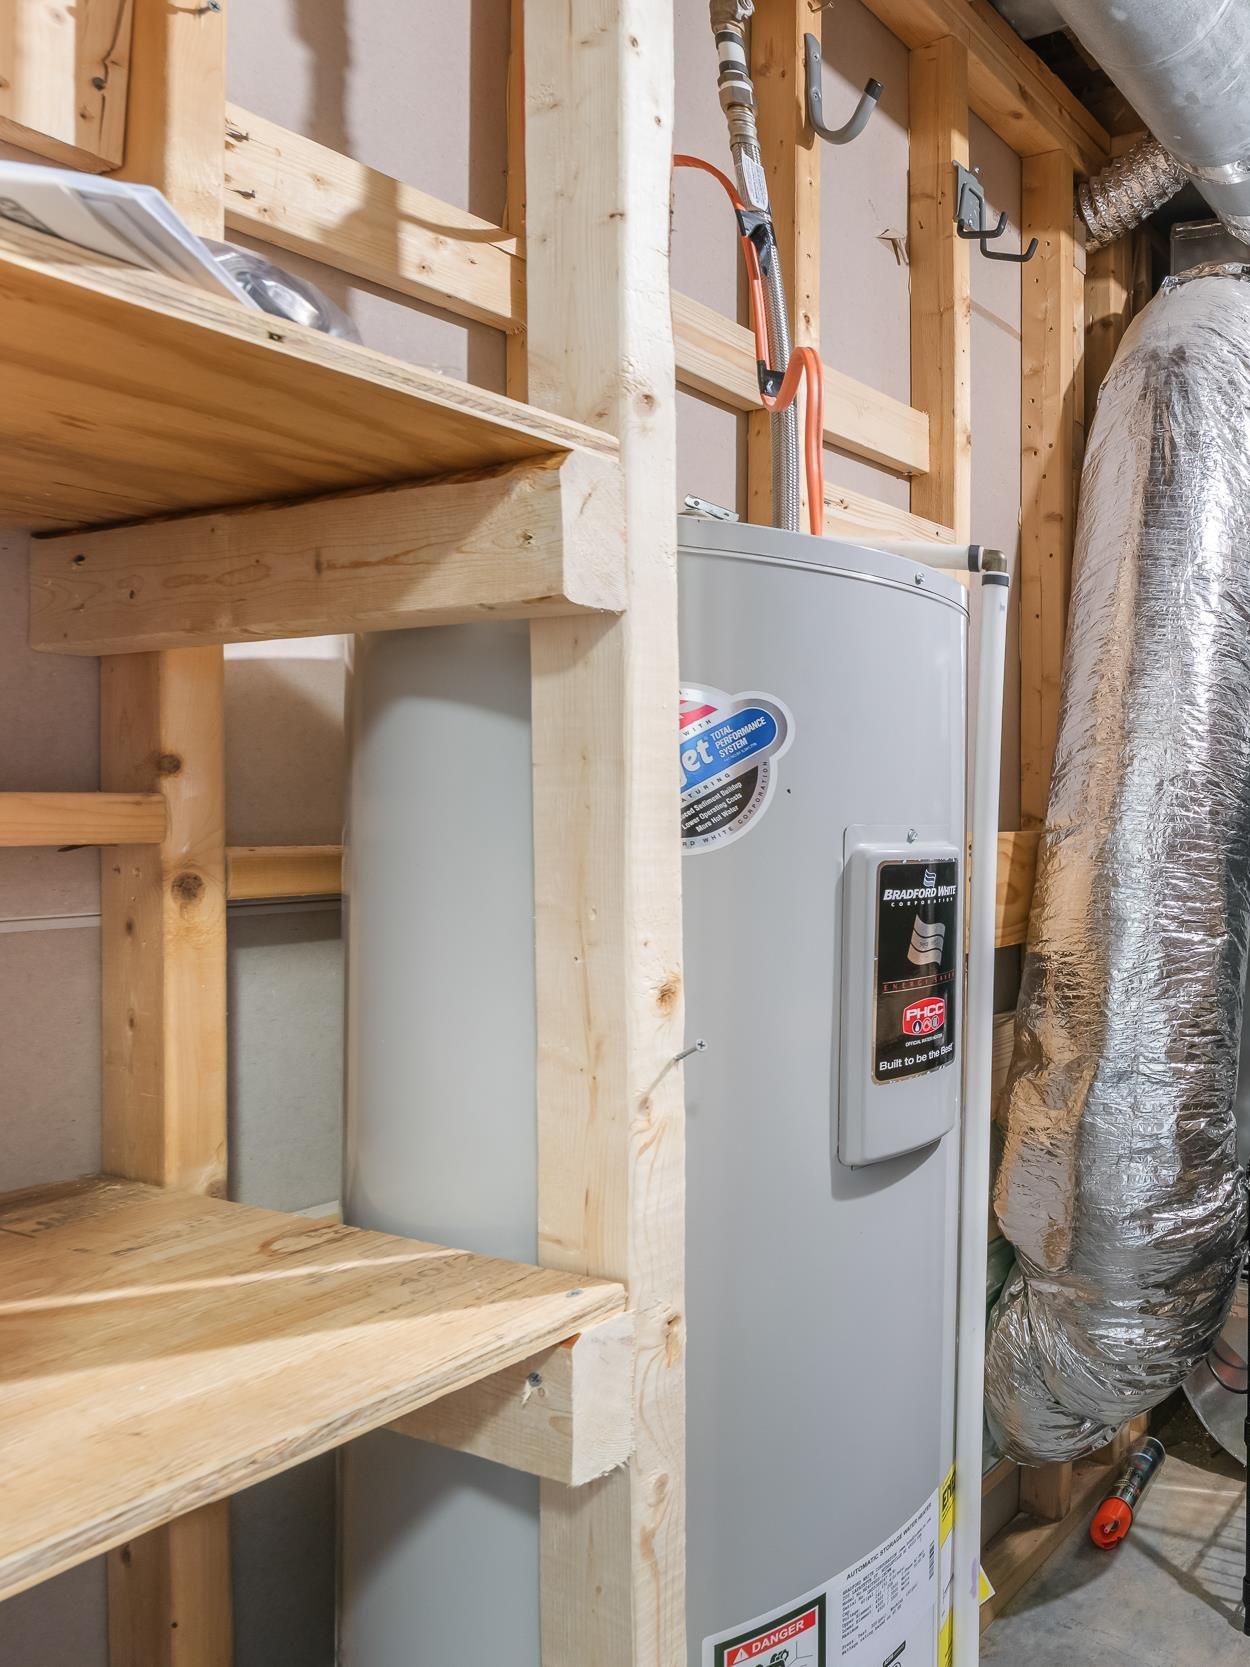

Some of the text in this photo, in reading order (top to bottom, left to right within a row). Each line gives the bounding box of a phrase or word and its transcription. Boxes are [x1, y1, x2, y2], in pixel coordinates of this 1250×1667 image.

[683, 719, 711, 737] WITH
[710, 725, 733, 741] TOTAL
[715, 716, 767, 749] PERFORMANCE
[719, 737, 748, 758] SYSTEM
[681, 772, 731, 802] ATURING
[694, 793, 721, 811] Sediment
[720, 782, 743, 797] Buildup
[681, 793, 743, 830] Lower Operating Costs
[702, 826, 734, 844] WHITE
[738, 761, 768, 825] CORPORATION
[695, 805, 739, 832] More Hot Water
[883, 885, 956, 900] BRADFORD WHITE
[883, 979, 928, 991] ENERGY
[905, 1002, 944, 1021] PHCC
[880, 1042, 953, 1071] Built to be the Best
[846, 1553, 879, 1580] AUTOMATIC
[880, 1533, 902, 1556] STORAGE
[903, 1518, 917, 1535] WATER
[917, 1502, 932, 1520] HEATER
[752, 1620, 804, 1653] DANGER
